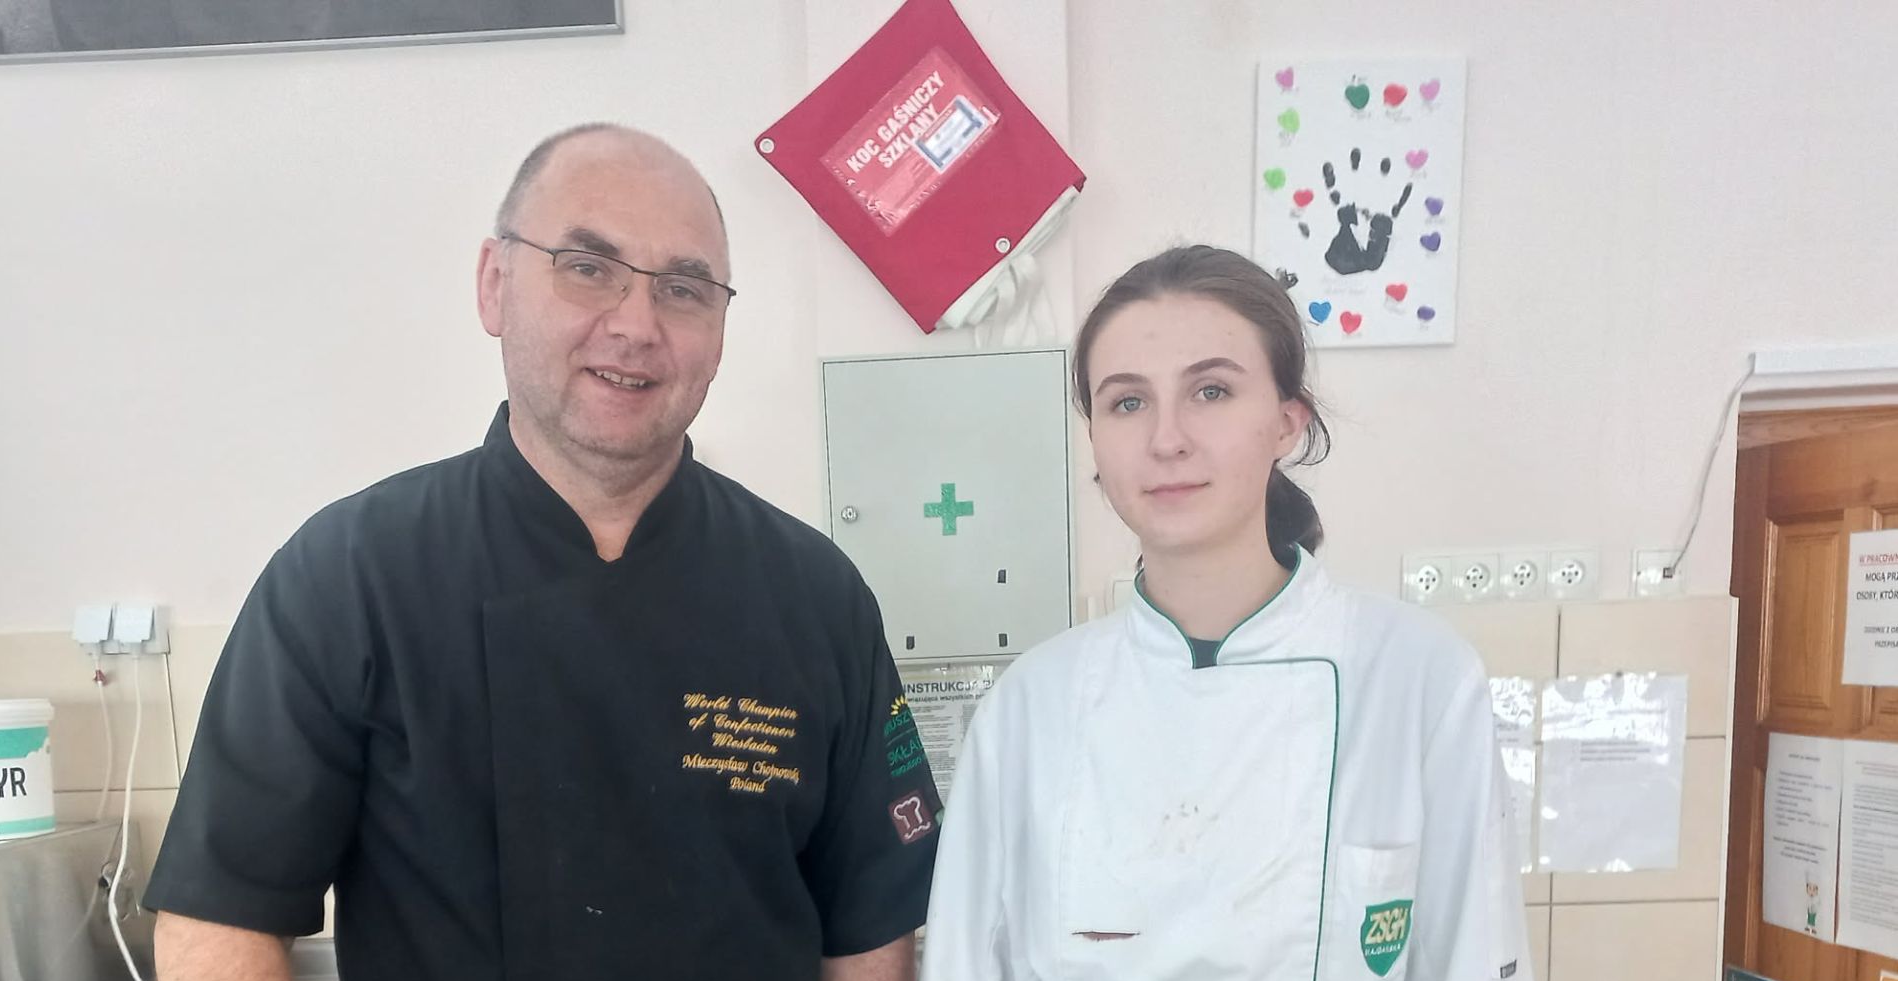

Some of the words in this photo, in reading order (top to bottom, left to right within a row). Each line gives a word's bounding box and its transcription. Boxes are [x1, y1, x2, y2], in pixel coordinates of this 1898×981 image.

[846, 138, 880, 173] KOC
[877, 71, 944, 144] GAŚNICZY
[683, 693, 732, 710] World
[738, 698, 798, 720] Champion
[688, 712, 708, 731] of
[714, 713, 796, 738] Confectioners
[712, 732, 779, 755] Wiesbaden
[729, 776, 766, 793] Poland
[1365, 907, 1408, 944] ZSGH
